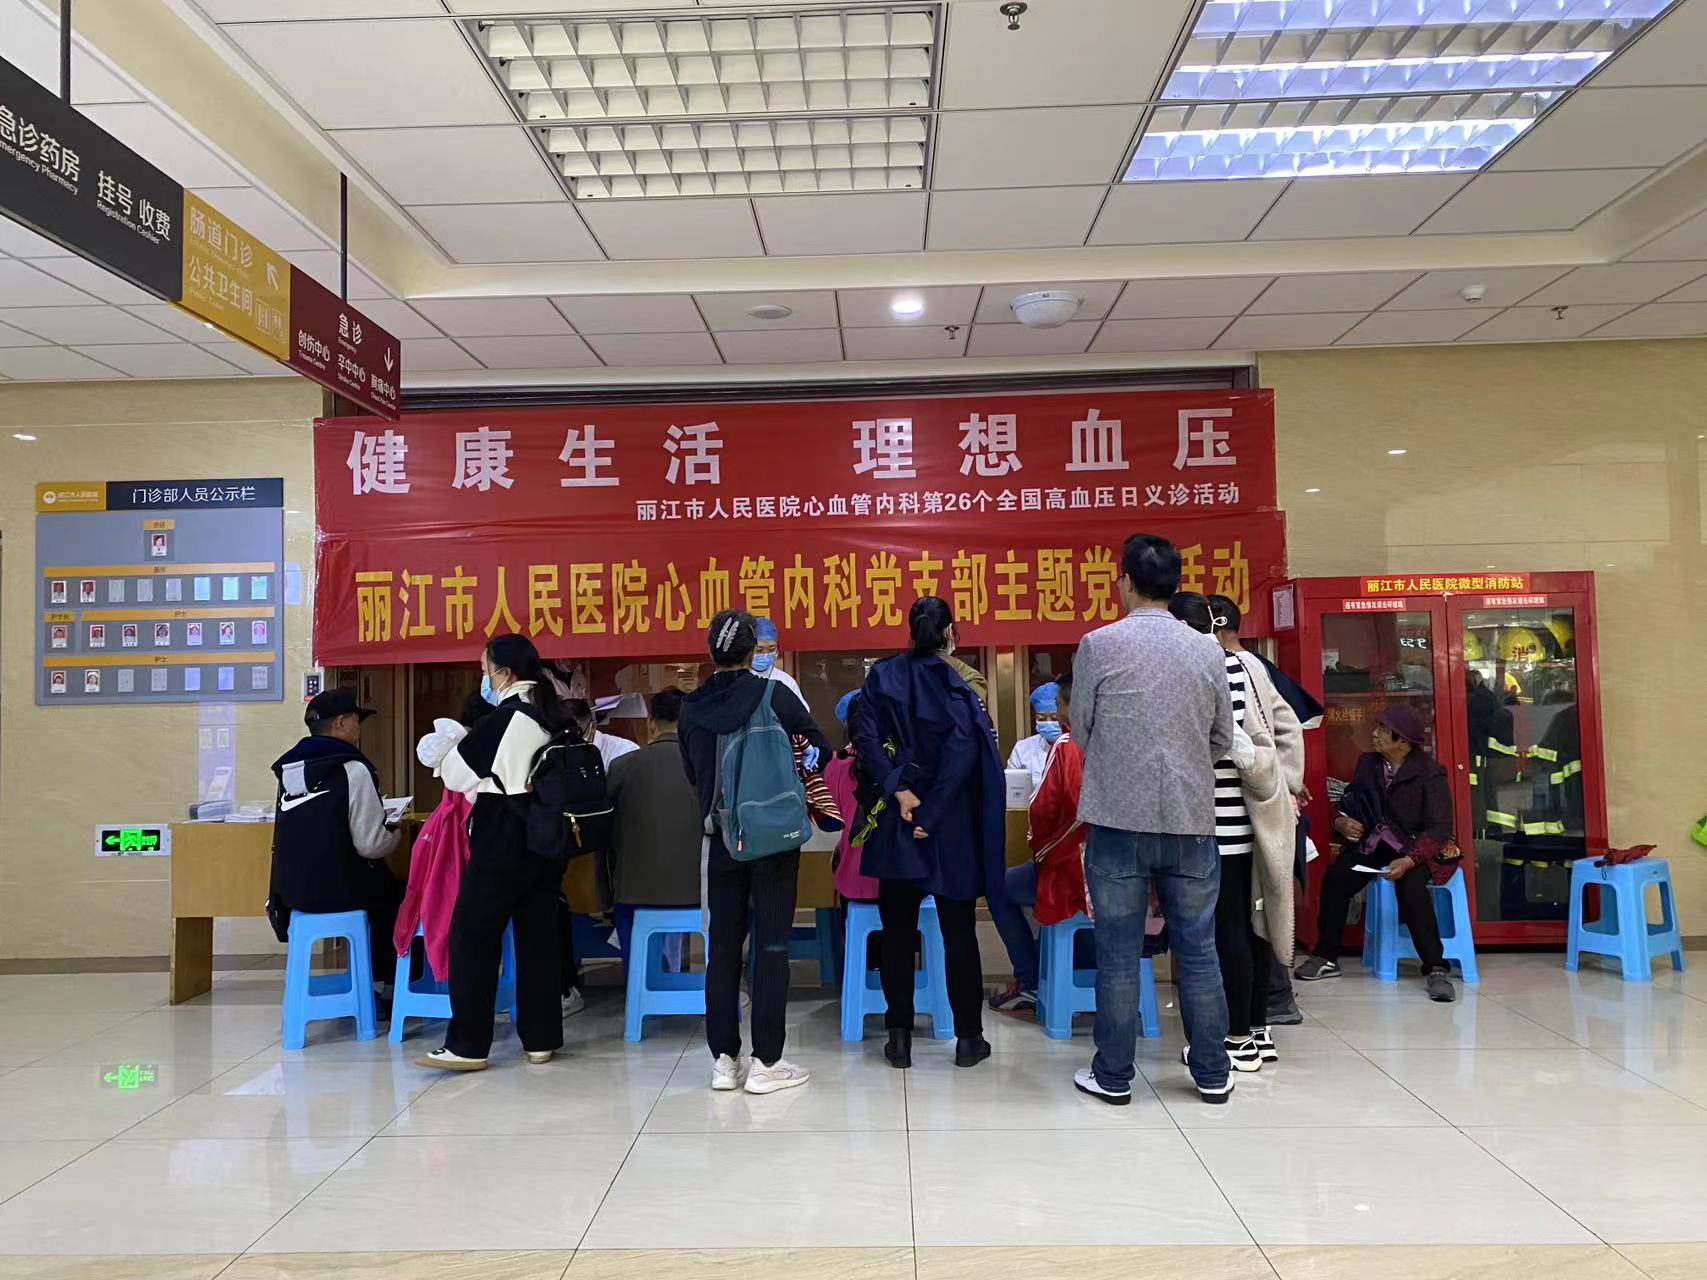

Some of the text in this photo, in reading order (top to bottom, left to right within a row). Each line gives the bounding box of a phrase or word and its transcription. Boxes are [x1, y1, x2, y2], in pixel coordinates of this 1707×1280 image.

[0, 104, 80, 182] 急诊药房
[0, 140, 79, 196] mergency Pharmacy
[97, 170, 170, 241] 挂号 收费
[97, 199, 137, 231] Registration
[190, 206, 253, 268] 肠道门诊
[189, 255, 253, 317] 公共卫生间
[298, 329, 331, 362] 创伤中心
[338, 313, 362, 345] 急诊
[346, 407, 1238, 496] 健康生活 理想血压
[132, 486, 256, 504] 门诊部人员公示栏
[635, 482, 1241, 522] 丽江市人民医院心血管内科第26个全国高血压日义诊活动
[355, 540, 1251, 643] 丽江市人民医院心血管内科党支部主题党动
[1366, 576, 1524, 593] 丽江市人民医院微型消防站
